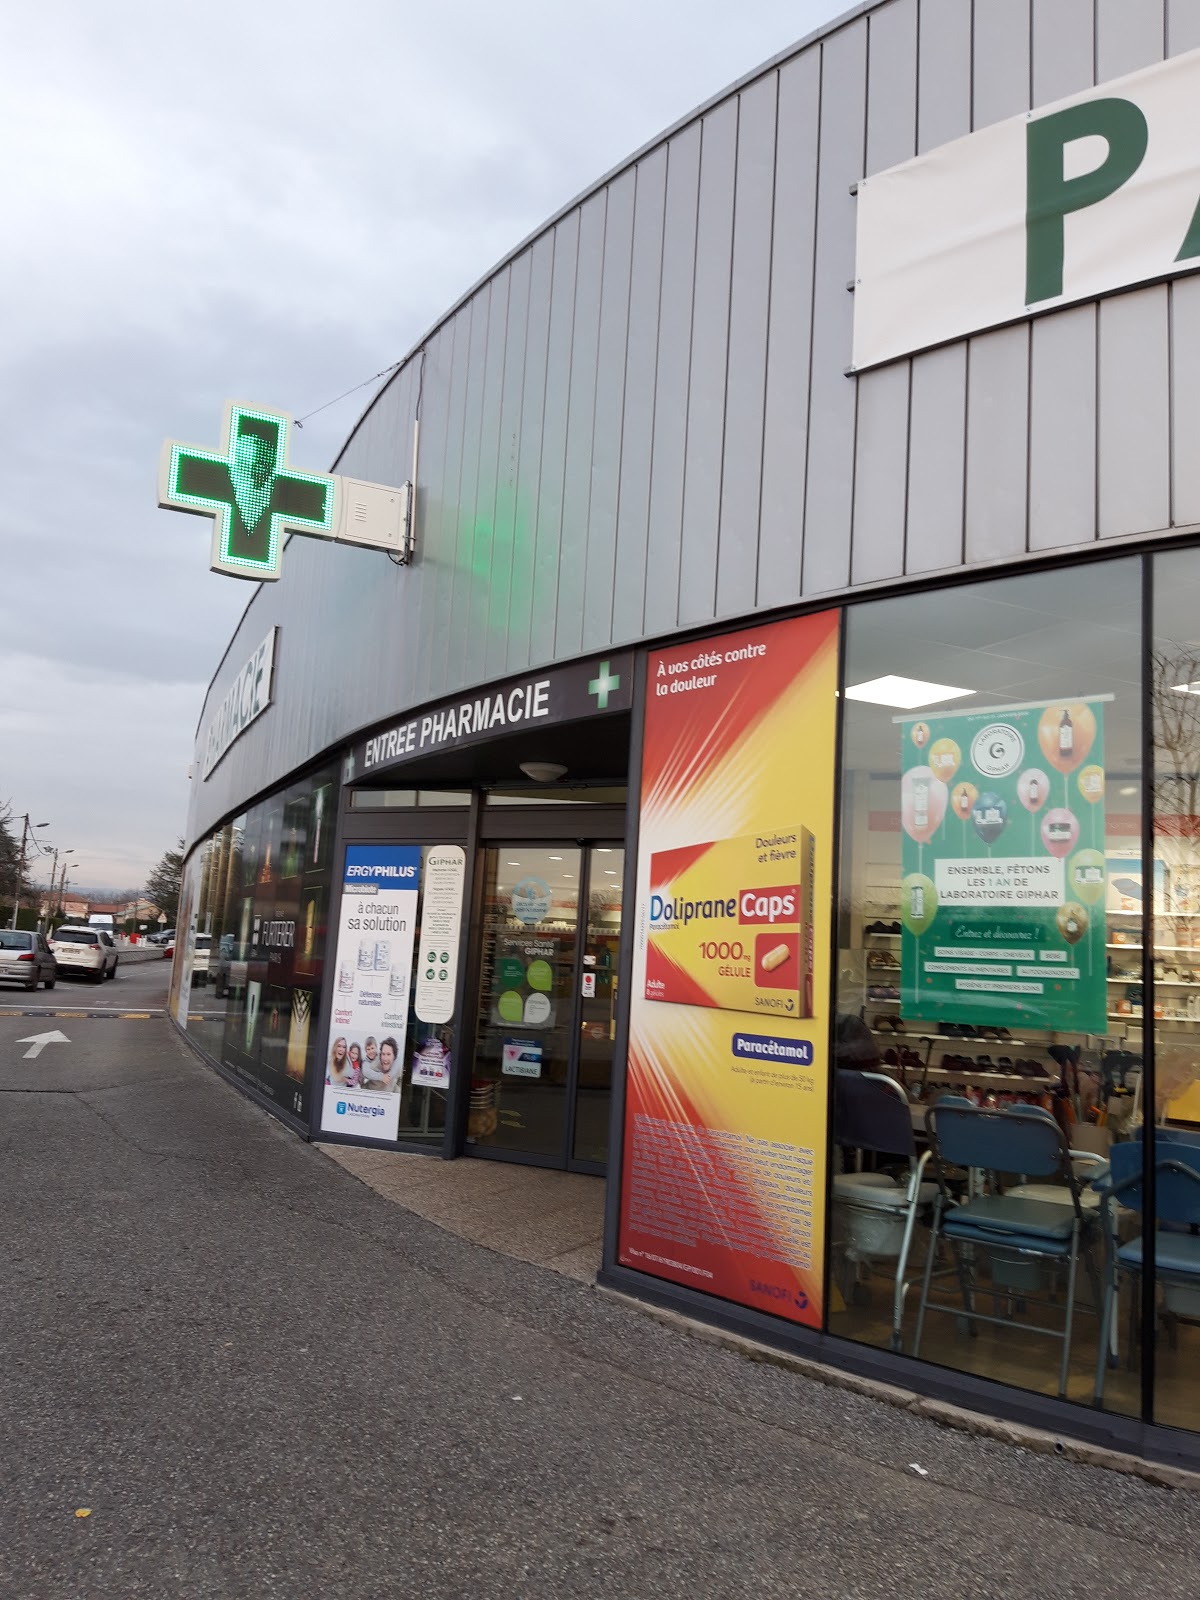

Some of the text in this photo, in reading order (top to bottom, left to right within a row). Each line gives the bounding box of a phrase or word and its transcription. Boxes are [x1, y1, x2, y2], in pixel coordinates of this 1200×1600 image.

[1025, 97, 1200, 306] P
[656, 643, 767, 677] À vos côtés contre
[655, 674, 717, 696] la douleur
[364, 680, 551, 768] ENTREE PHARMACIE
[755, 833, 797, 849] Douleurs
[428, 856, 463, 866] GIPHAR
[758, 849, 796, 863] et fièvre
[947, 864, 1051, 875] ENSEMBLE, FÊTONS
[967, 878, 985, 887] LES
[996, 878, 1011, 886] AN
[1013, 878, 1028, 886] DE
[940, 890, 1059, 899] LABORATOIRE GIPHAR
[357, 901, 399, 915] à chacun
[650, 892, 795, 926] Doliprane Caps
[347, 916, 406, 932] sa solution
[983, 929, 992, 939] et
[524, 947, 554, 956] GIPHAR
[699, 941, 743, 960] 1000
[718, 965, 751, 978] GÉLULE
[754, 997, 783, 1008] SANOFI
[736, 1038, 809, 1060] Paracétamol
[347, 1102, 385, 1117] Nutergia
